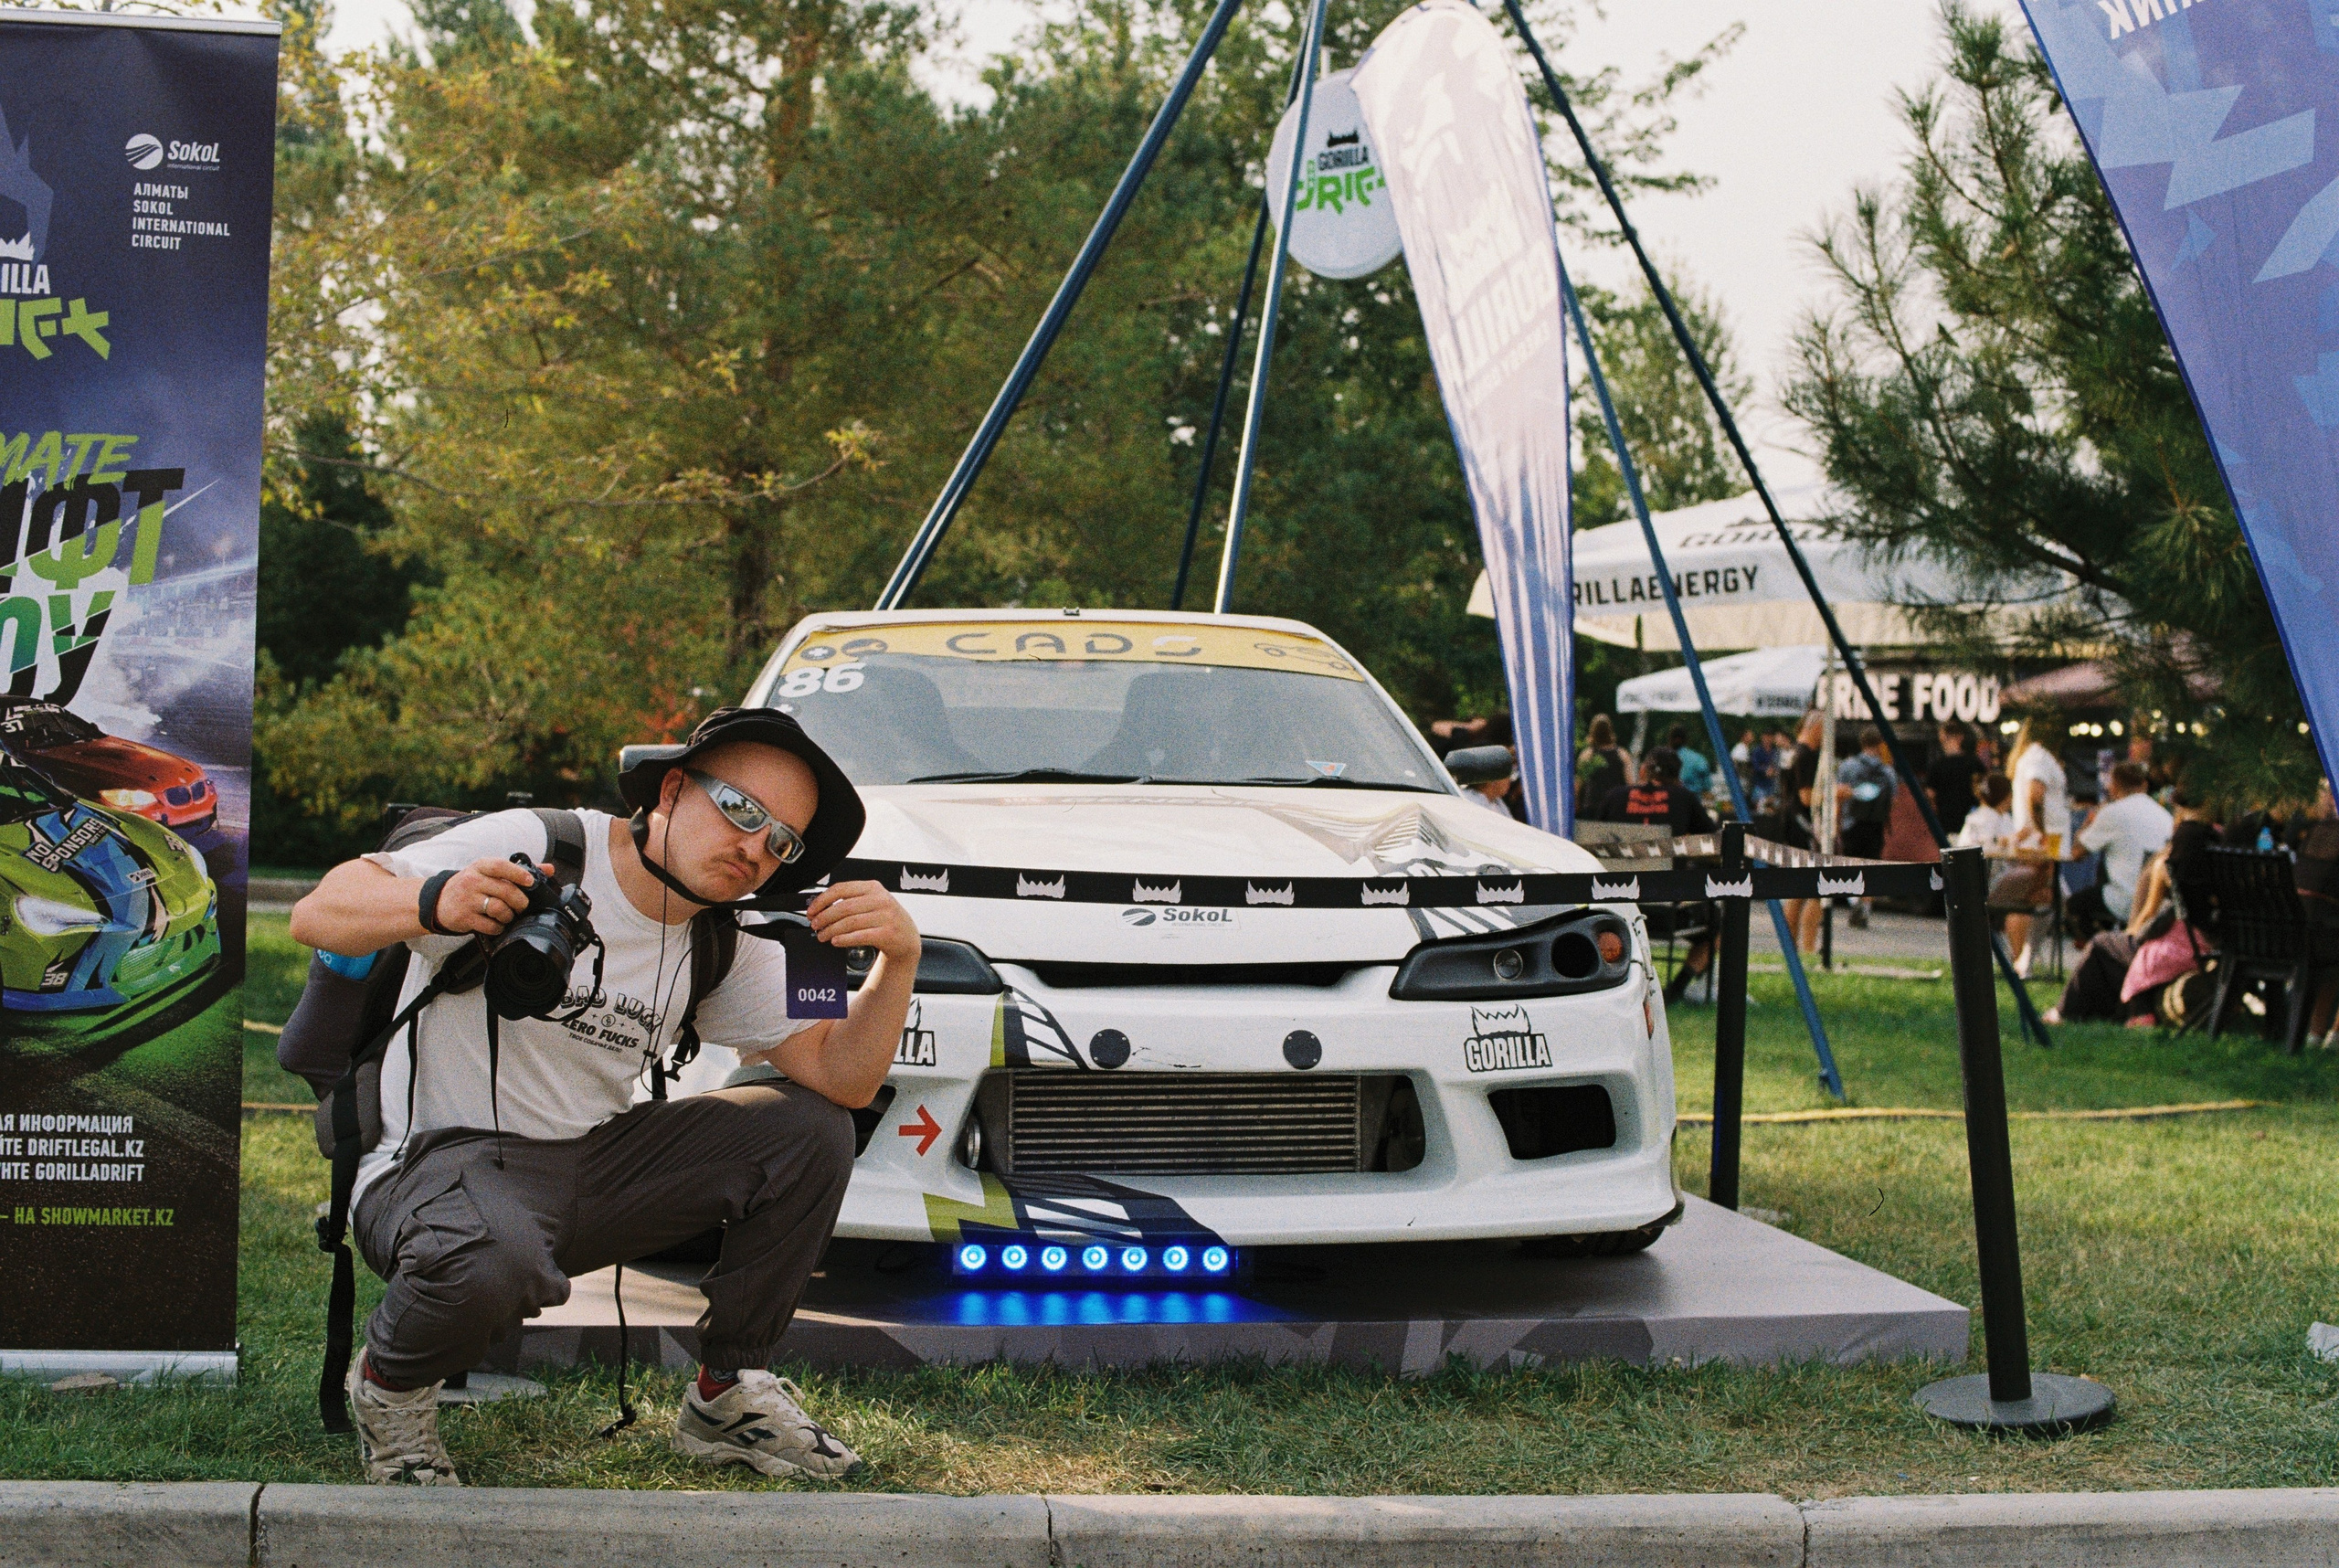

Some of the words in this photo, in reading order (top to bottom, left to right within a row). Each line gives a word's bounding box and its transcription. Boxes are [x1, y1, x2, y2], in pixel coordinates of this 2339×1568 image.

[133, 183, 188, 199] АЛМАТЫ
[132, 199, 174, 215] SOKOL
[132, 217, 230, 237] INTERNATIONAL
[132, 234, 182, 249] CIRCUIT
[778, 662, 867, 699] 86
[1913, 672, 2001, 724] FOOD
[798, 988, 837, 1002] 0042
[598, 1029, 640, 1048] FUCKS
[1465, 1034, 1552, 1072] GORILLA
[19, 1114, 133, 1136] ИНФОРМАЦИЯ
[27, 1138, 144, 1158] DRIFTLEGAL.KZ
[35, 1162, 145, 1181] GORILLADRIFT
[15, 1207, 36, 1224] НА
[41, 1207, 175, 1226] SHOWMARKET.KZ
